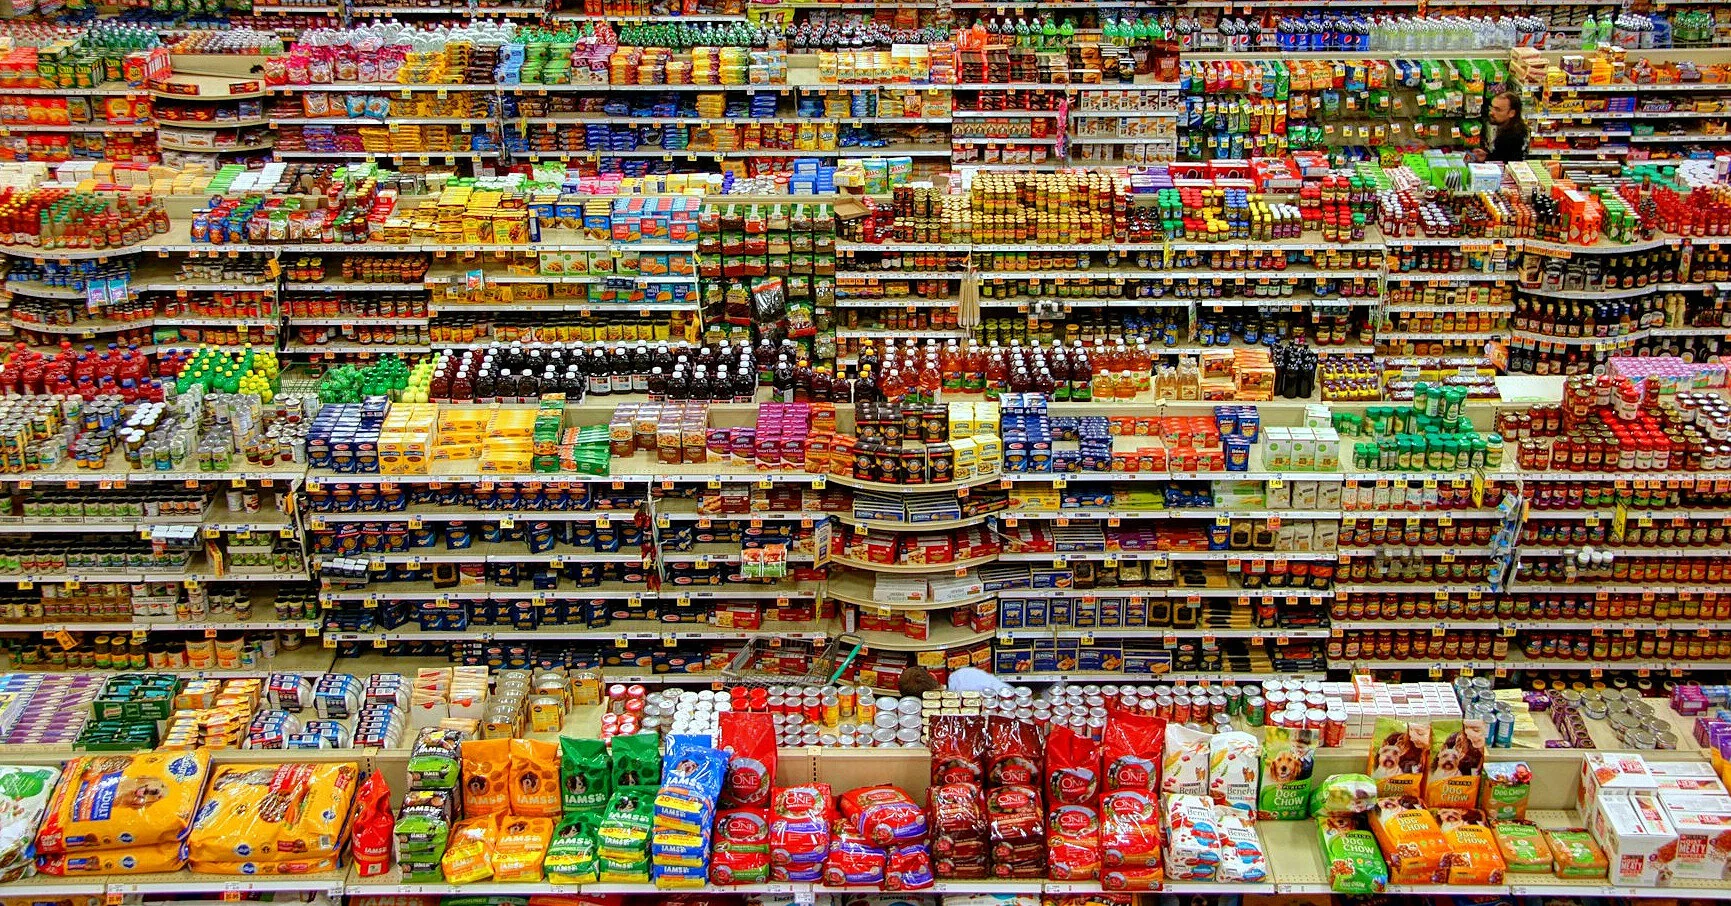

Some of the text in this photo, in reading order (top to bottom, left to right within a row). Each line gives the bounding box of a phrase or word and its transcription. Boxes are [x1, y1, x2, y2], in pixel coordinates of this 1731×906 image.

[732, 775, 758, 785] ONE
[1001, 771, 1027, 782] ONE
[1119, 771, 1146, 782] ONE
[666, 777, 696, 787] IAMS
[1276, 789, 1297, 797] DOG
[1443, 785, 1462, 794] DOG
[467, 796, 495, 804] IAMS
[517, 795, 546, 804] IAMS
[565, 794, 596, 803] IAMS
[786, 796, 812, 805] ONE
[1274, 796, 1304, 806] CHOW
[1441, 793, 1468, 801] CHOW
[100, 790, 112, 818] ADULT
[609, 812, 638, 820] IAMS
[662, 808, 681, 817] IAMS
[1397, 817, 1418, 825] DOG
[1400, 823, 1429, 832] CHOW
[553, 838, 582, 846] IAMS
[605, 837, 625, 845] IAMS
[1341, 838, 1364, 846] DOG
[1343, 844, 1374, 854] CHOW
[1679, 843, 1706, 854] MEATY
[608, 861, 626, 869] IAMS
